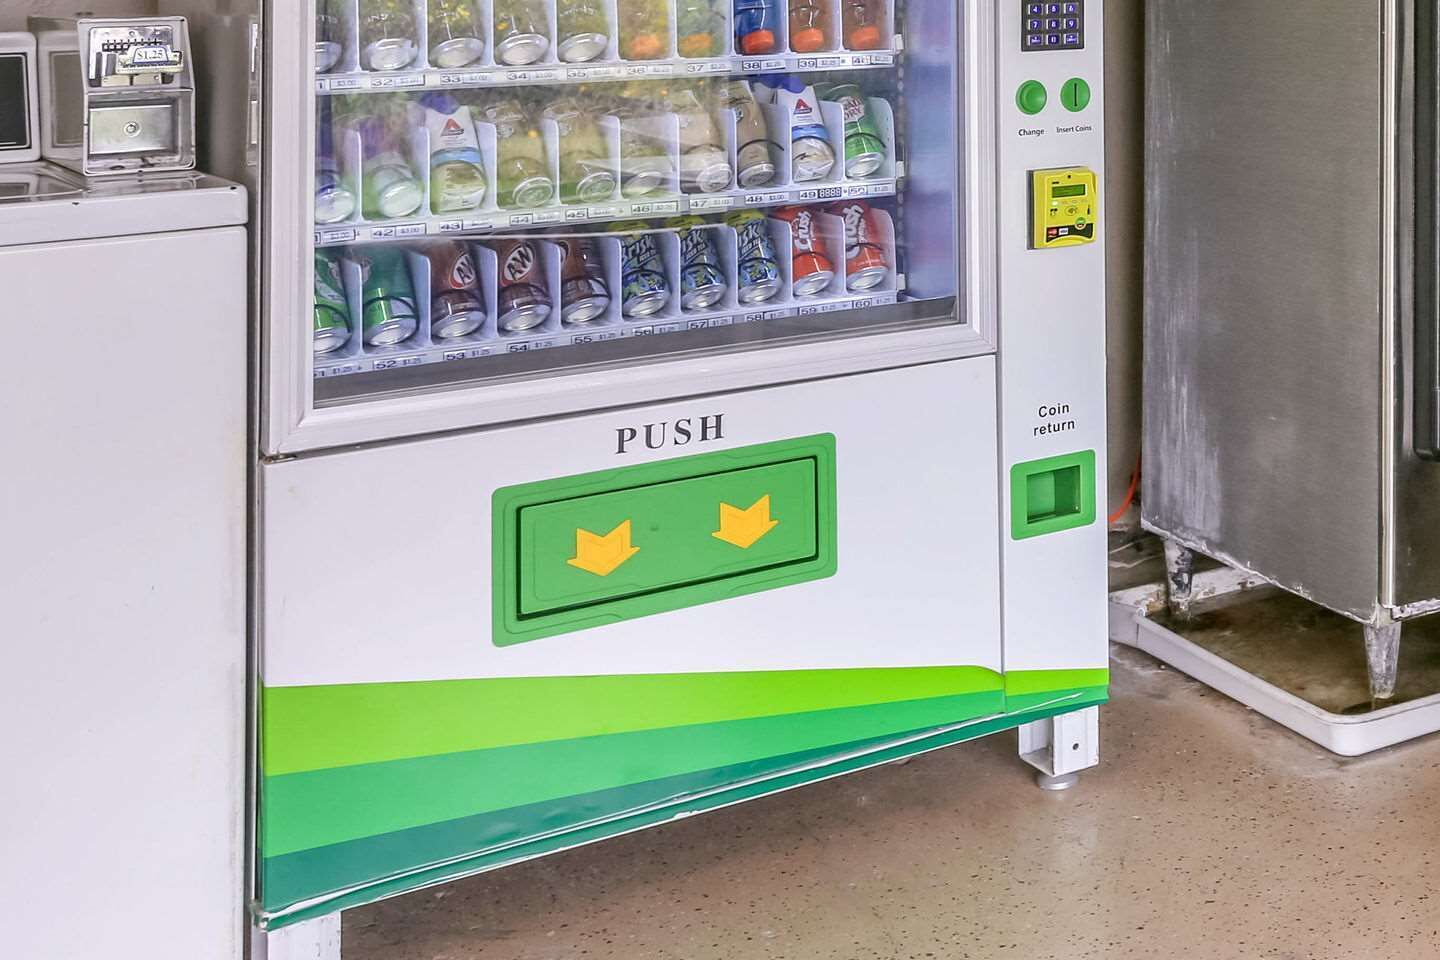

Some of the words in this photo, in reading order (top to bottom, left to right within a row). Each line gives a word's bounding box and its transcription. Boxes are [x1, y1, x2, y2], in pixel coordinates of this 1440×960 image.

[137, 47, 163, 61] $1.25
[743, 61, 760, 71] 38
[801, 59, 815, 68] 39
[687, 64, 703, 74] 37
[441, 75, 460, 84] 33
[508, 72, 527, 81] 34
[372, 78, 392, 87] 32
[1018, 128, 1045, 137] Change
[1056, 126, 1074, 134] Insert
[1076, 125, 1092, 133] Coins
[746, 195, 763, 204] 48
[801, 191, 816, 199] 49
[691, 200, 708, 209] 47
[633, 205, 650, 214] 46
[567, 210, 586, 219] 45
[512, 216, 529, 224] 44
[441, 221, 460, 230] 43
[372, 228, 393, 237] 42
[855, 299, 871, 309] 60
[801, 306, 817, 316] 59
[746, 314, 762, 323] 58
[690, 321, 707, 330] 57
[574, 335, 592, 344] 55
[509, 343, 528, 352] 54
[445, 351, 465, 361] 53
[375, 360, 397, 370] 52
[1038, 403, 1070, 418] Coin
[1033, 419, 1075, 436] return
[616, 413, 725, 454] PUSH
